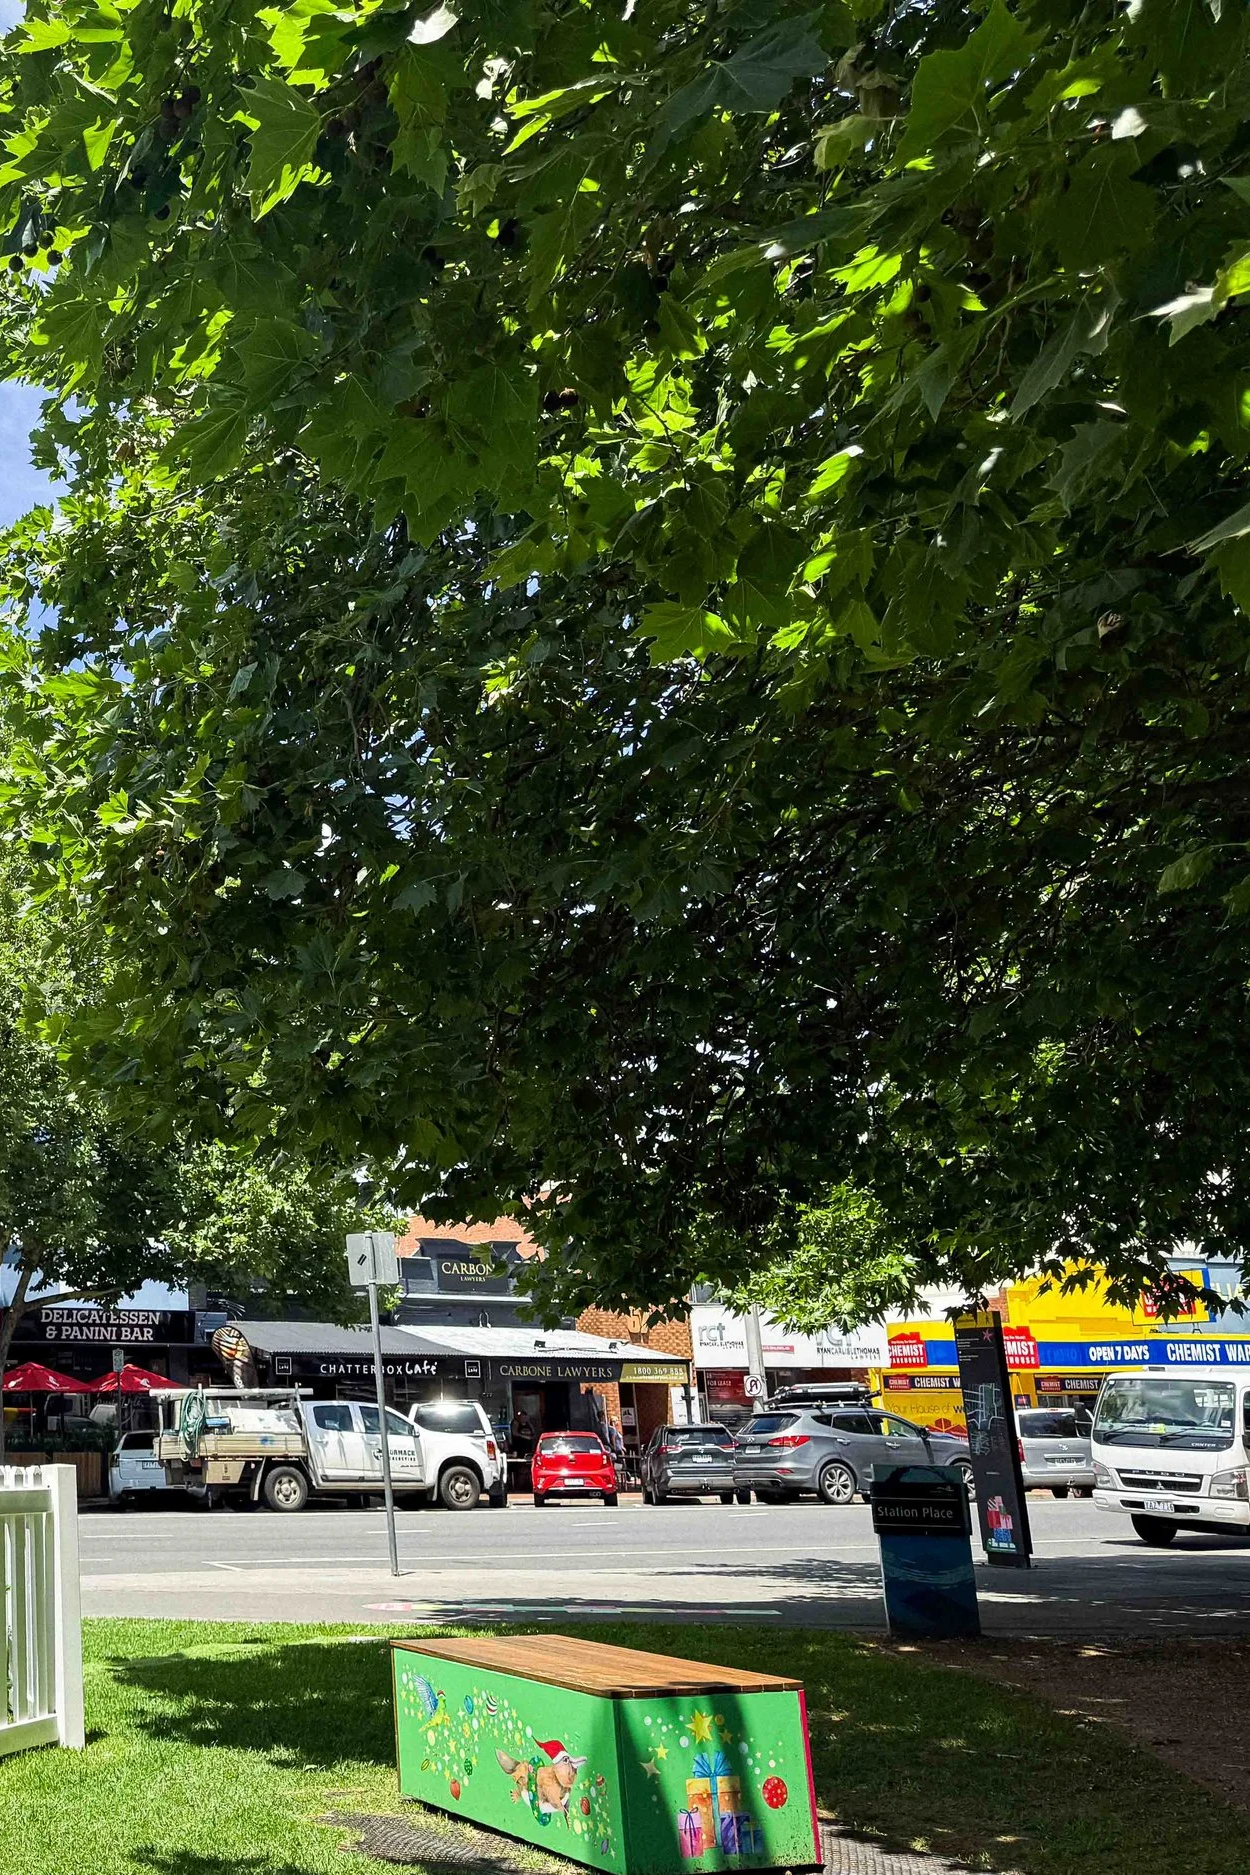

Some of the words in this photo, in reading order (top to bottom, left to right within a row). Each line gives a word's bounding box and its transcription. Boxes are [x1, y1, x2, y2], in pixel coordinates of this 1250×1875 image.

[441, 1261, 495, 1275] CARBON
[460, 1275, 486, 1283] LAWYERS
[41, 1309, 160, 1325] DELICATESSEN
[46, 1327, 58, 1339] &
[61, 1327, 117, 1340] PANINI
[121, 1328, 154, 1341] BAR
[1088, 1347, 1115, 1361] OPEN
[1115, 1346, 1123, 1361] 7
[1124, 1345, 1150, 1360] DAYS
[1166, 1344, 1221, 1362] CHEMIST
[500, 1365, 551, 1377] CARBONE
[557, 1366, 612, 1378] LAWYERS
[633, 1366, 651, 1375] 1800
[914, 1377, 950, 1388] CHEMIST
[1065, 1379, 1099, 1389] CHEMIST
[911, 1402, 941, 1413] House
[877, 1506, 918, 1518] Station
[922, 1507, 954, 1519] Place
